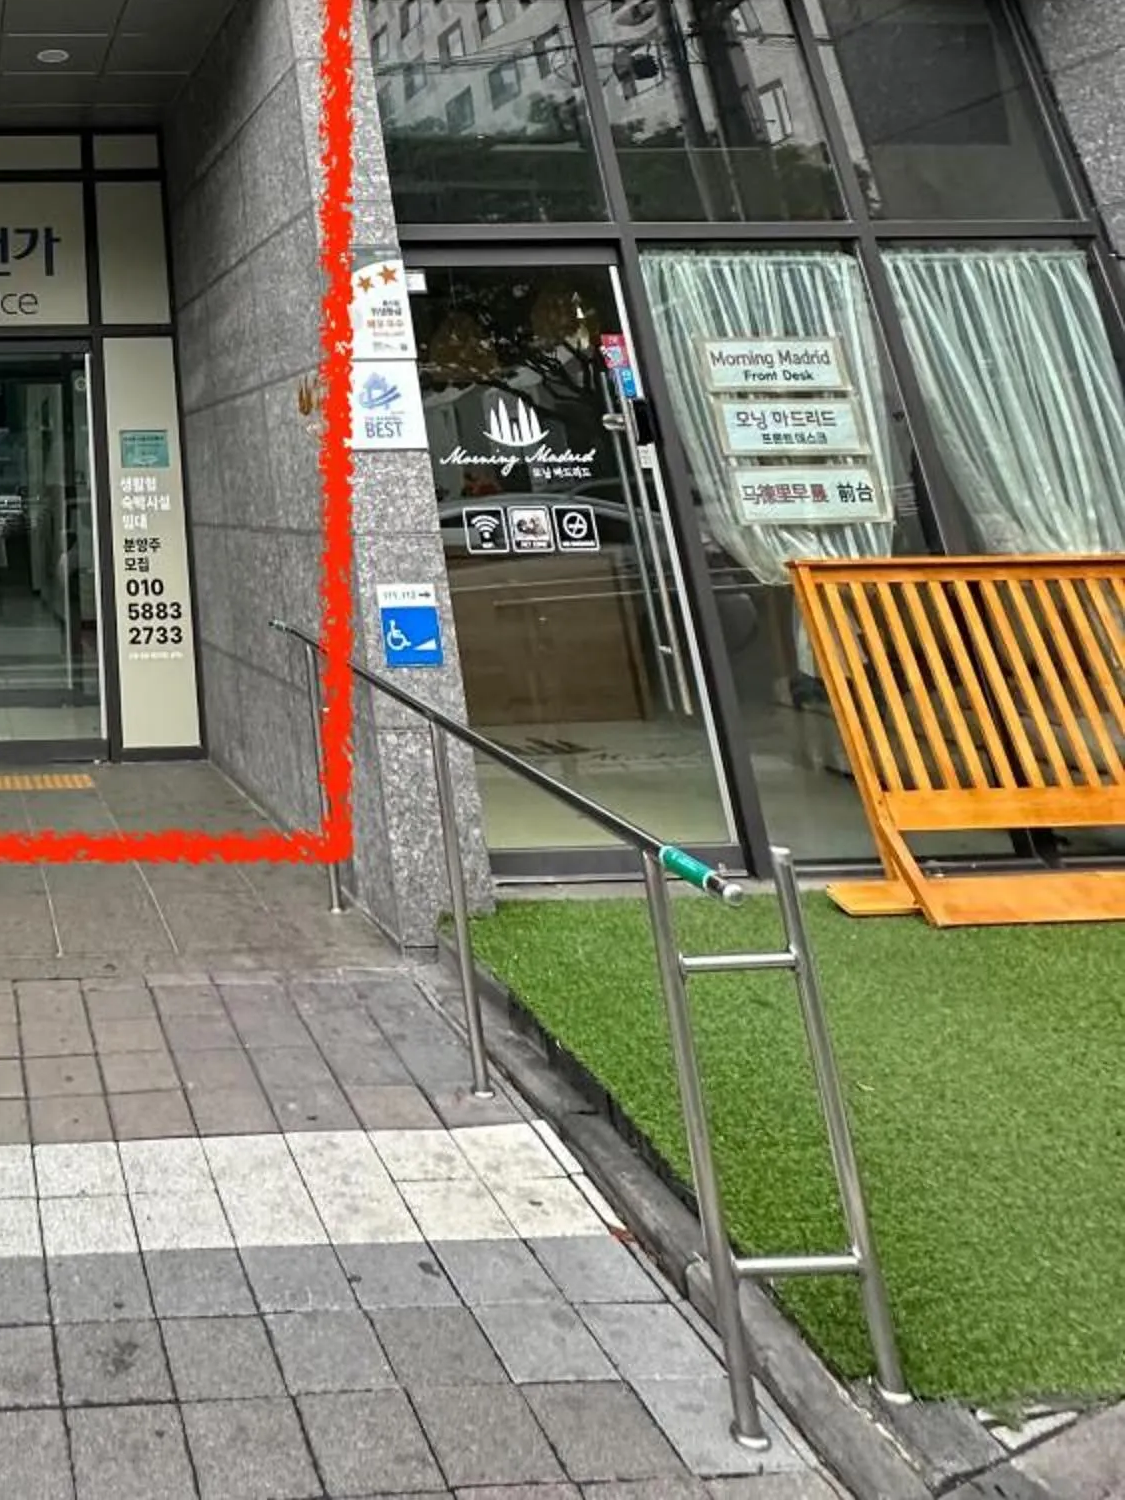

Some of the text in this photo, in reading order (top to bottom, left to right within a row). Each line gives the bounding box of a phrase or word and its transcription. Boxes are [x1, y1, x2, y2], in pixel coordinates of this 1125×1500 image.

[711, 349, 831, 368] Morning Madrid
[744, 370, 815, 381] Front Desk
[364, 421, 403, 438] BEST
[736, 410, 837, 430] 모닝 마드리드
[440, 444, 596, 477] Morning Madrid
[836, 480, 873, 503] 前台
[123, 537, 161, 553] 분양주
[124, 557, 150, 573] 모집
[126, 579, 164, 597] 010
[128, 602, 182, 621] 5883
[128, 626, 183, 645] 2733
